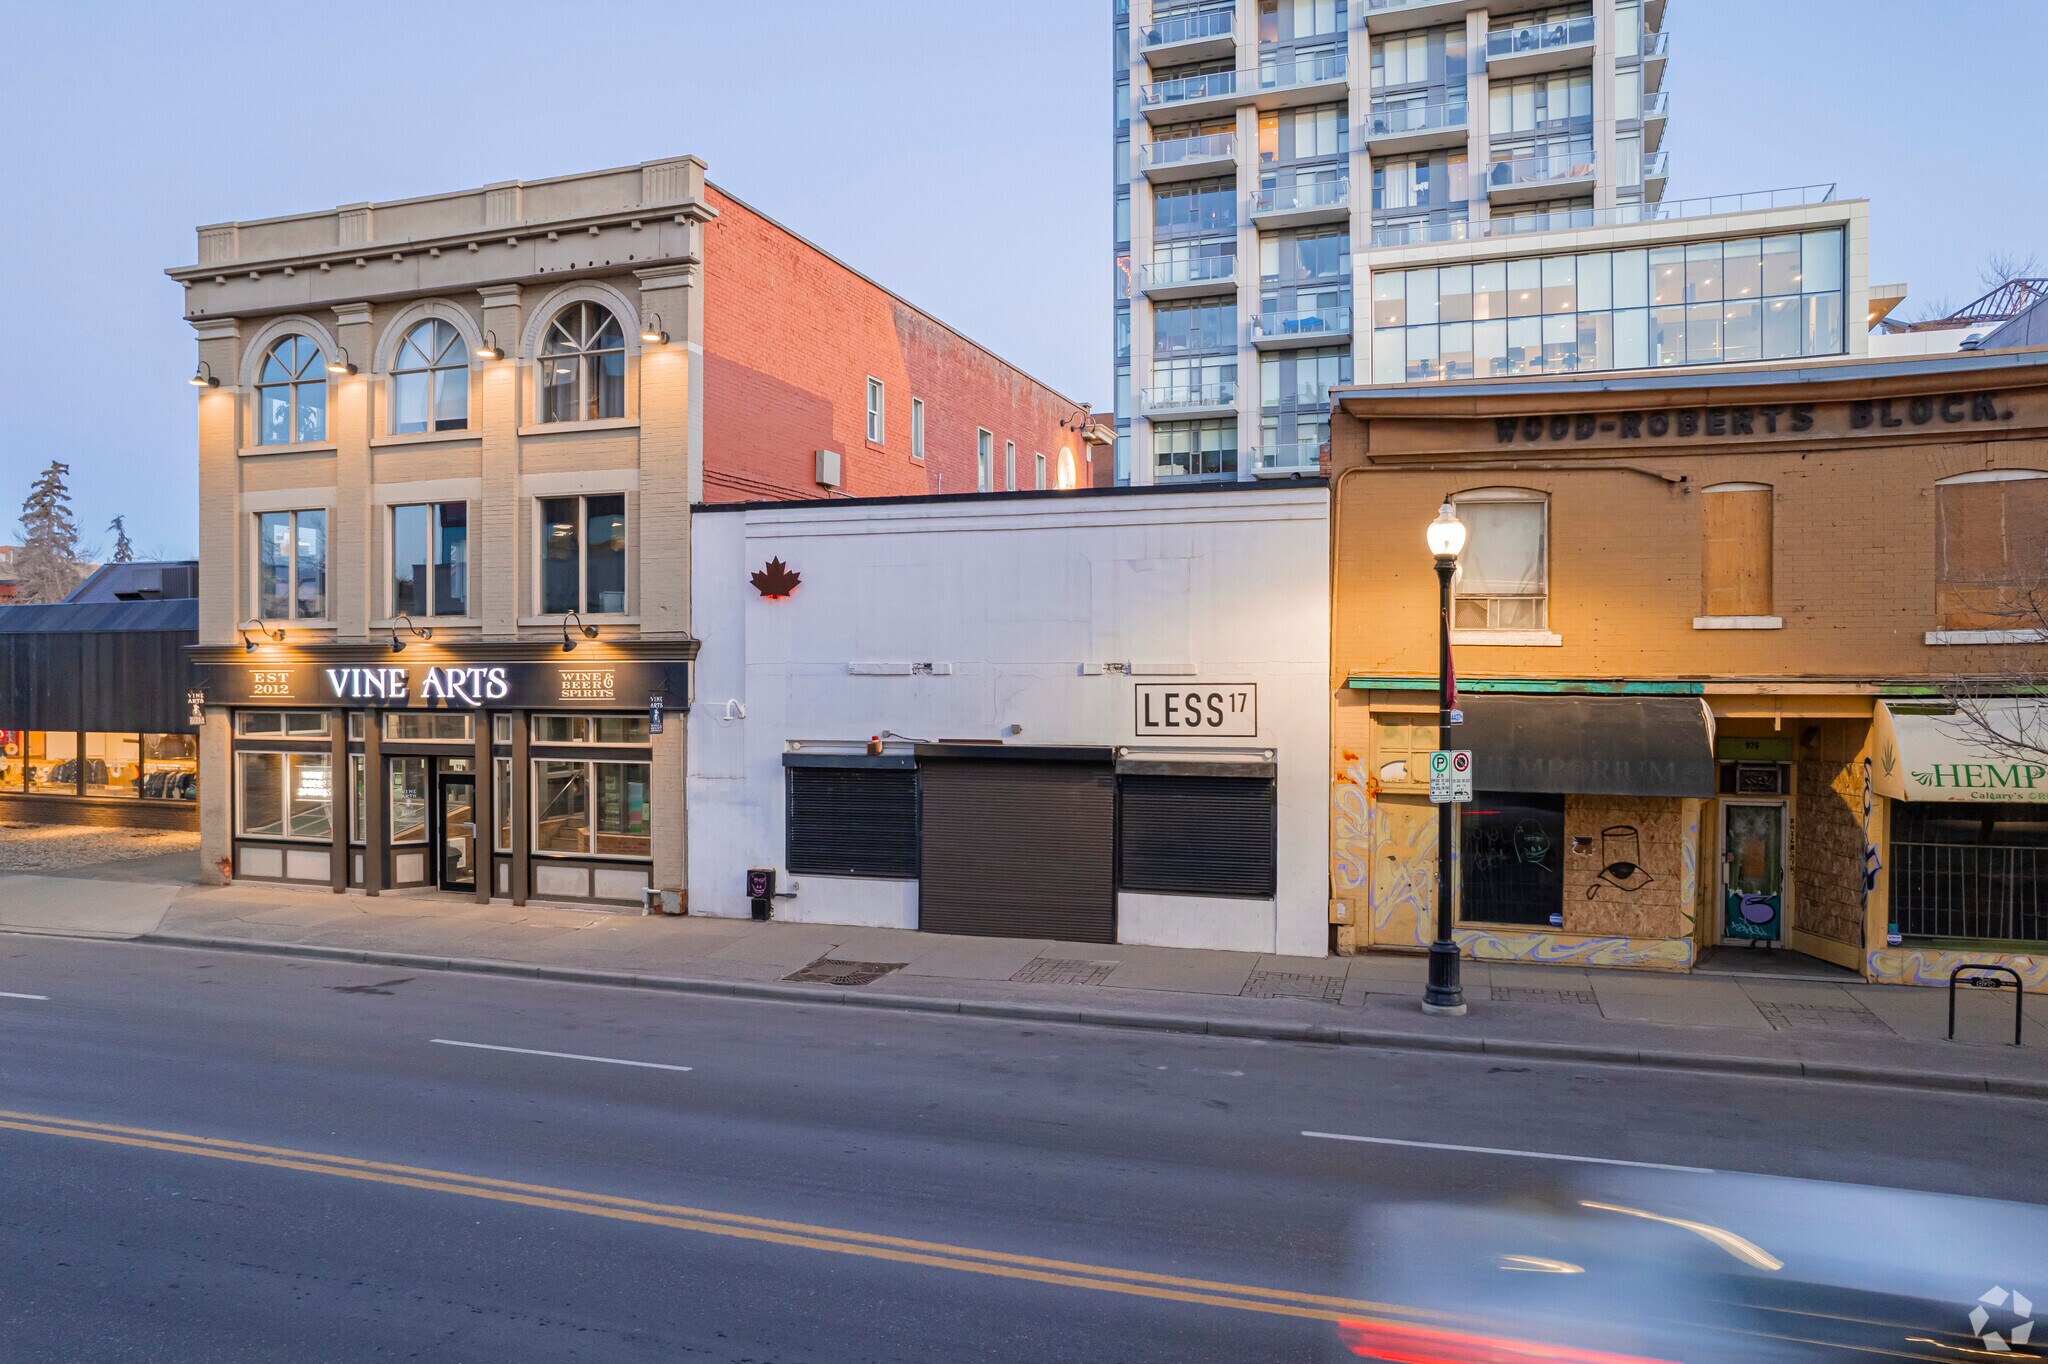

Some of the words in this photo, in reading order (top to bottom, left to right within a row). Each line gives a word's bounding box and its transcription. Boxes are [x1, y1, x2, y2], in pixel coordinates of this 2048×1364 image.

[254, 672, 289, 683] EST
[561, 672, 602, 681] WINE
[254, 684, 289, 695] 2012
[325, 667, 407, 699] VINE
[420, 666, 509, 706] ARTS
[561, 681, 602, 689] BEER
[561, 689, 614, 698] SPIRITS
[1144, 692, 1224, 728] LESS
[1228, 692, 1247, 713] 17
[1475, 754, 1677, 784] HMPORIUM
[1931, 763, 2048, 789] HEMP
